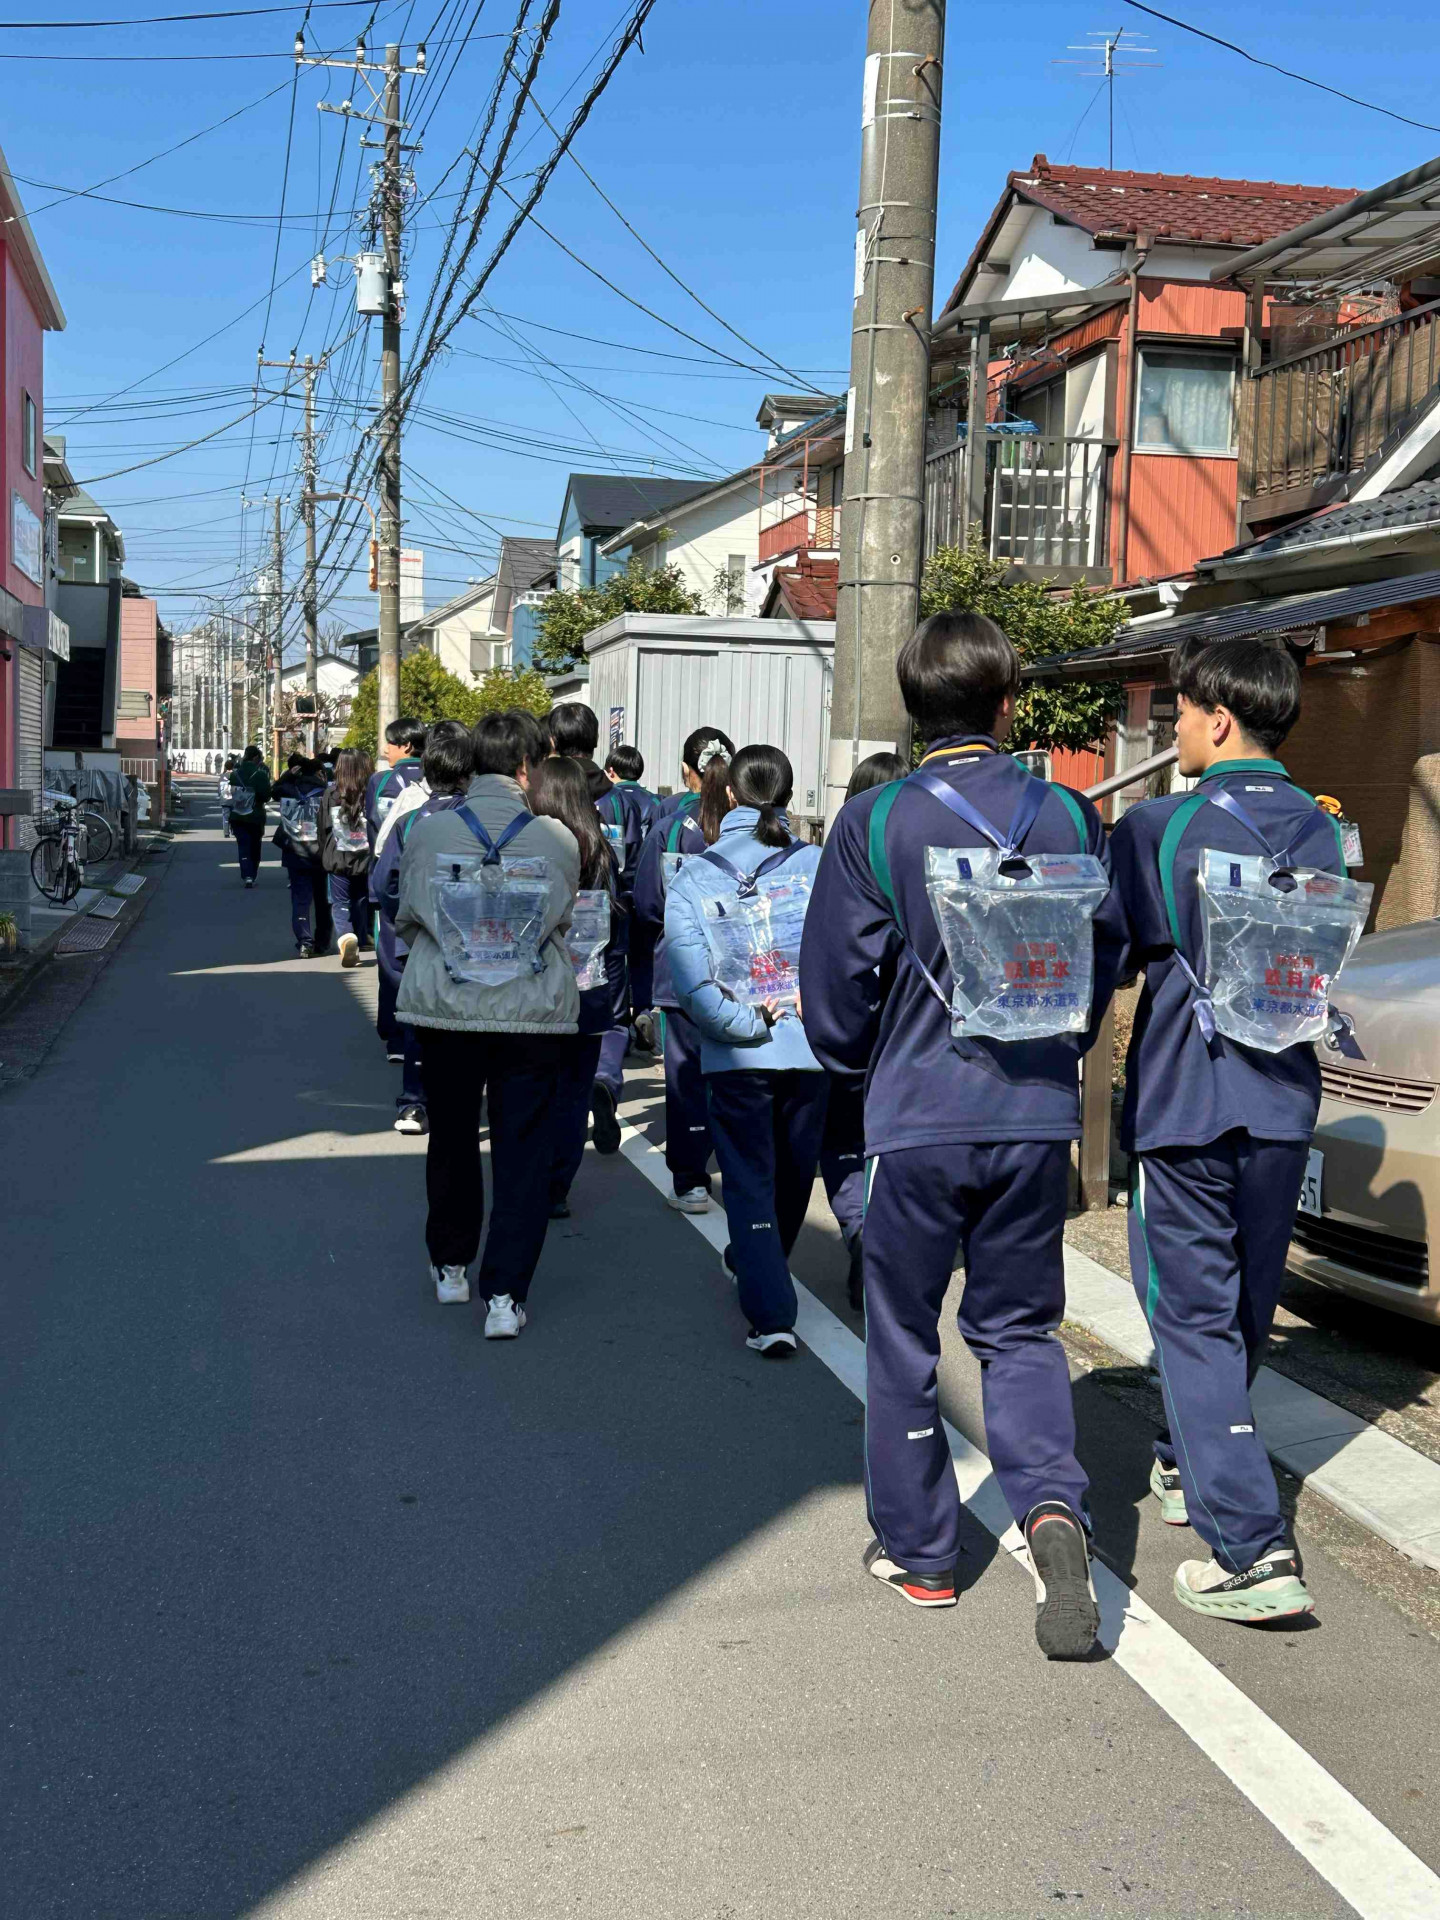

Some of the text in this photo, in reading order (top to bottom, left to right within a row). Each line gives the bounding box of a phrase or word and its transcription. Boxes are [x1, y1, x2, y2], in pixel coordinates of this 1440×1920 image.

[1004, 959, 1071, 980] 飲料水
[1264, 968, 1325, 992] 飲料水
[997, 993, 1079, 1009] 東京都水道局
[1252, 997, 1326, 1017] 東京都水道局
[1222, 1563, 1274, 1591] SKECHERS
